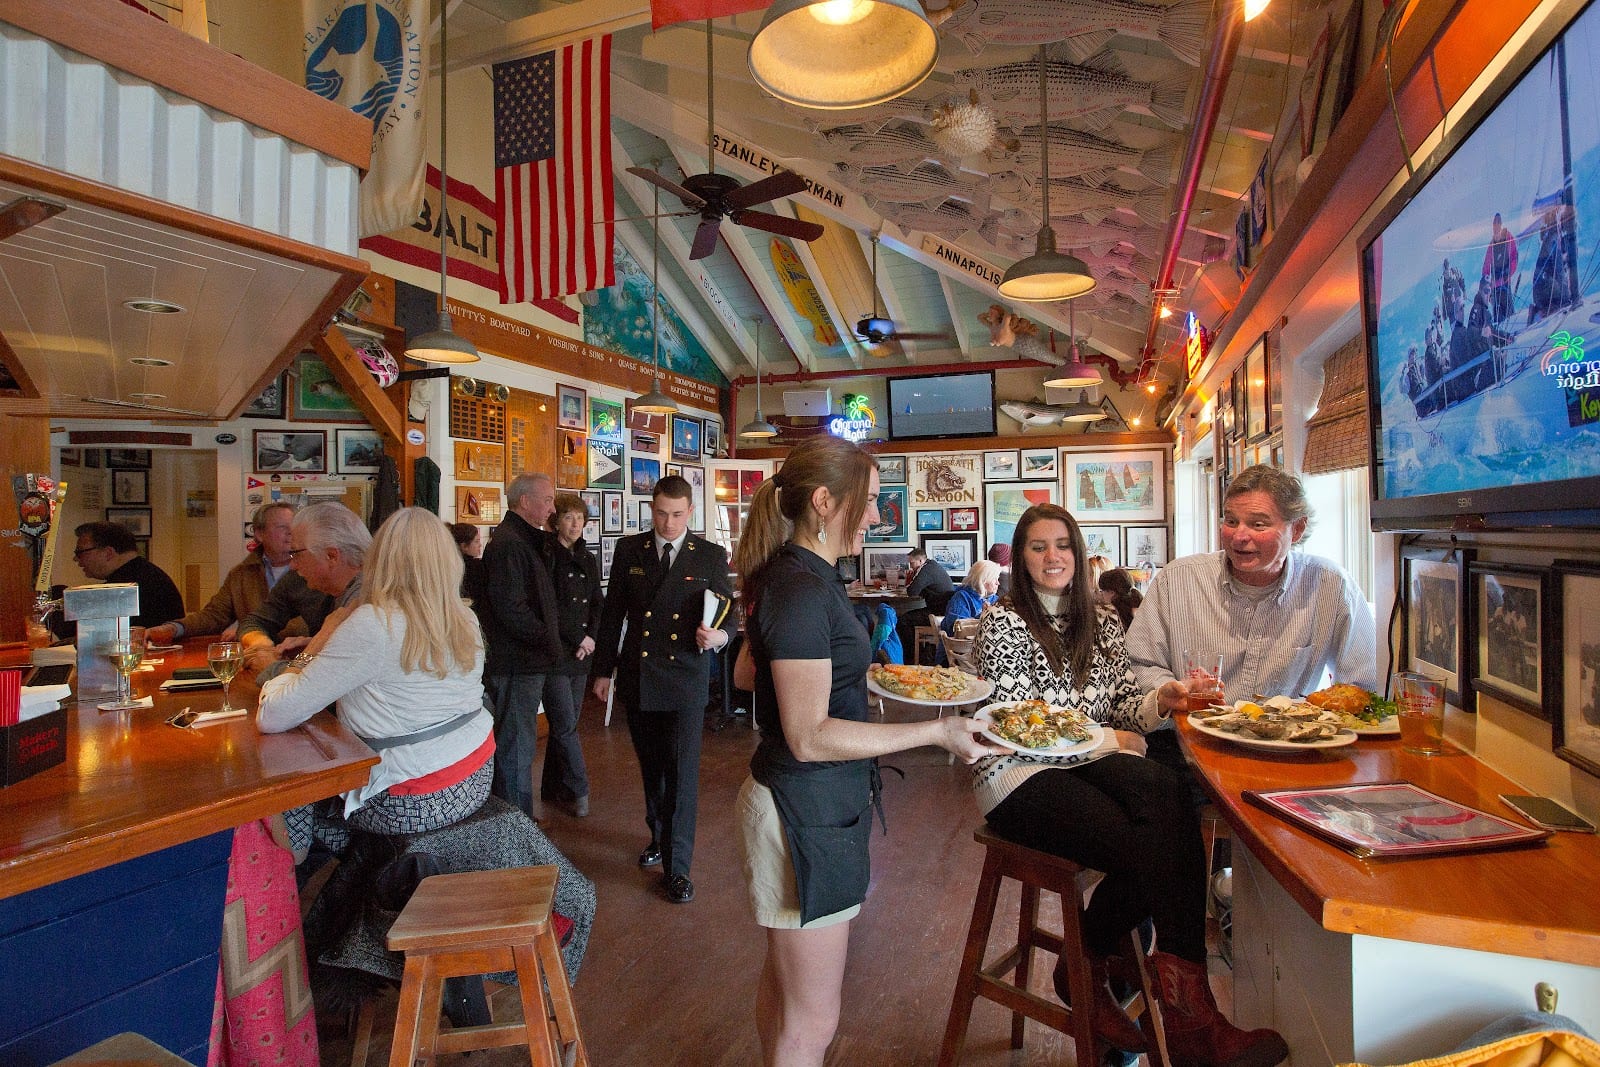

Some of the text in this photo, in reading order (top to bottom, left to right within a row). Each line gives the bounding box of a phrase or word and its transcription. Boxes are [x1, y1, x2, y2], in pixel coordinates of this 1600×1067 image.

[713, 134, 780, 175] STANLEY
[936, 245, 1001, 285] ANNAPOLIS
[445, 303, 486, 324] SMITTY'S
[490, 317, 530, 338] BOATYARD
[548, 336, 579, 353] VOSBURY
[581, 347, 587, 356] &
[589, 350, 605, 362] SONS
[831, 418, 871, 433] Corona
[915, 488, 975, 503] SALOON
